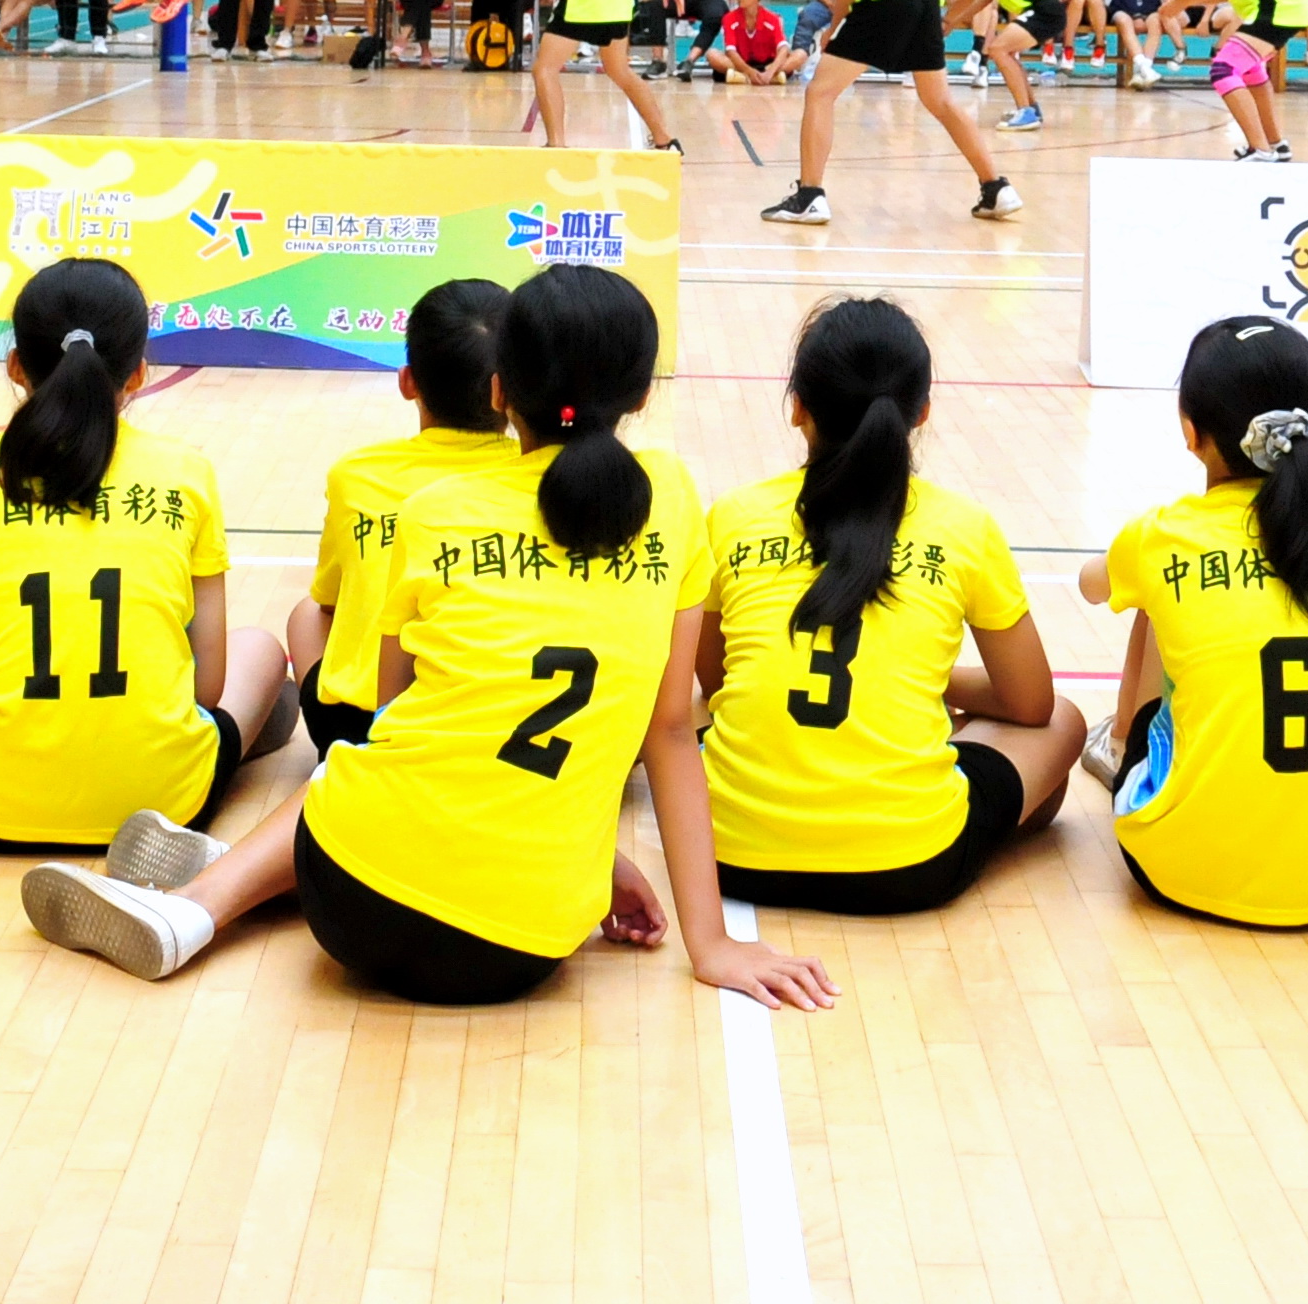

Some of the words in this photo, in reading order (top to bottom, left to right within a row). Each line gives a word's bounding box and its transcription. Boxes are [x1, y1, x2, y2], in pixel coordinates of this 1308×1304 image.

[81, 206, 115, 216] MEN
[82, 192, 132, 203] JIANG
[80, 221, 129, 238] 江门
[286, 214, 438, 241] 中国体育彩票
[561, 211, 624, 239] 体汇
[285, 241, 324, 252] CHINA
[328, 243, 376, 254] SPORTS
[379, 243, 436, 255] LOTTERY
[545, 239, 622, 258] 体育传媒
[147, 303, 296, 333] 育无处不在
[19, 567, 129, 701] 11
[787, 614, 863, 730] 3
[495, 645, 600, 781] 2
